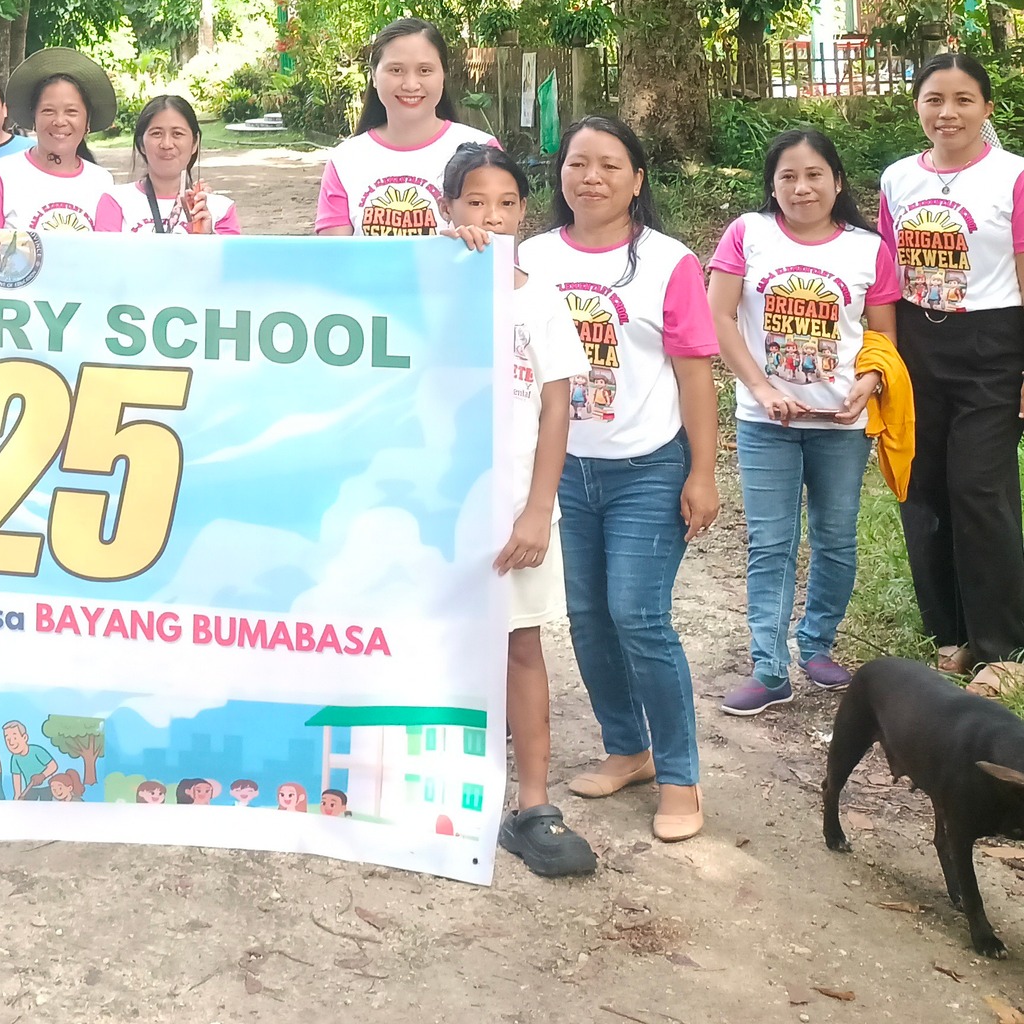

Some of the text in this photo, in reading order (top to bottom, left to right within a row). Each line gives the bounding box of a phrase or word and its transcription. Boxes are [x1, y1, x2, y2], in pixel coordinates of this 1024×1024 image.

[363, 206, 438, 228] BRIGADA
[897, 230, 969, 252] BRIGADA
[897, 247, 971, 271] ESKWELA
[764, 294, 840, 322] BRIGADA
[105, 303, 411, 369] SCHOOL
[763, 312, 842, 341] ESKWELA
[35, 602, 183, 643] BAYANG
[192, 613, 393, 657] BUMABASA
